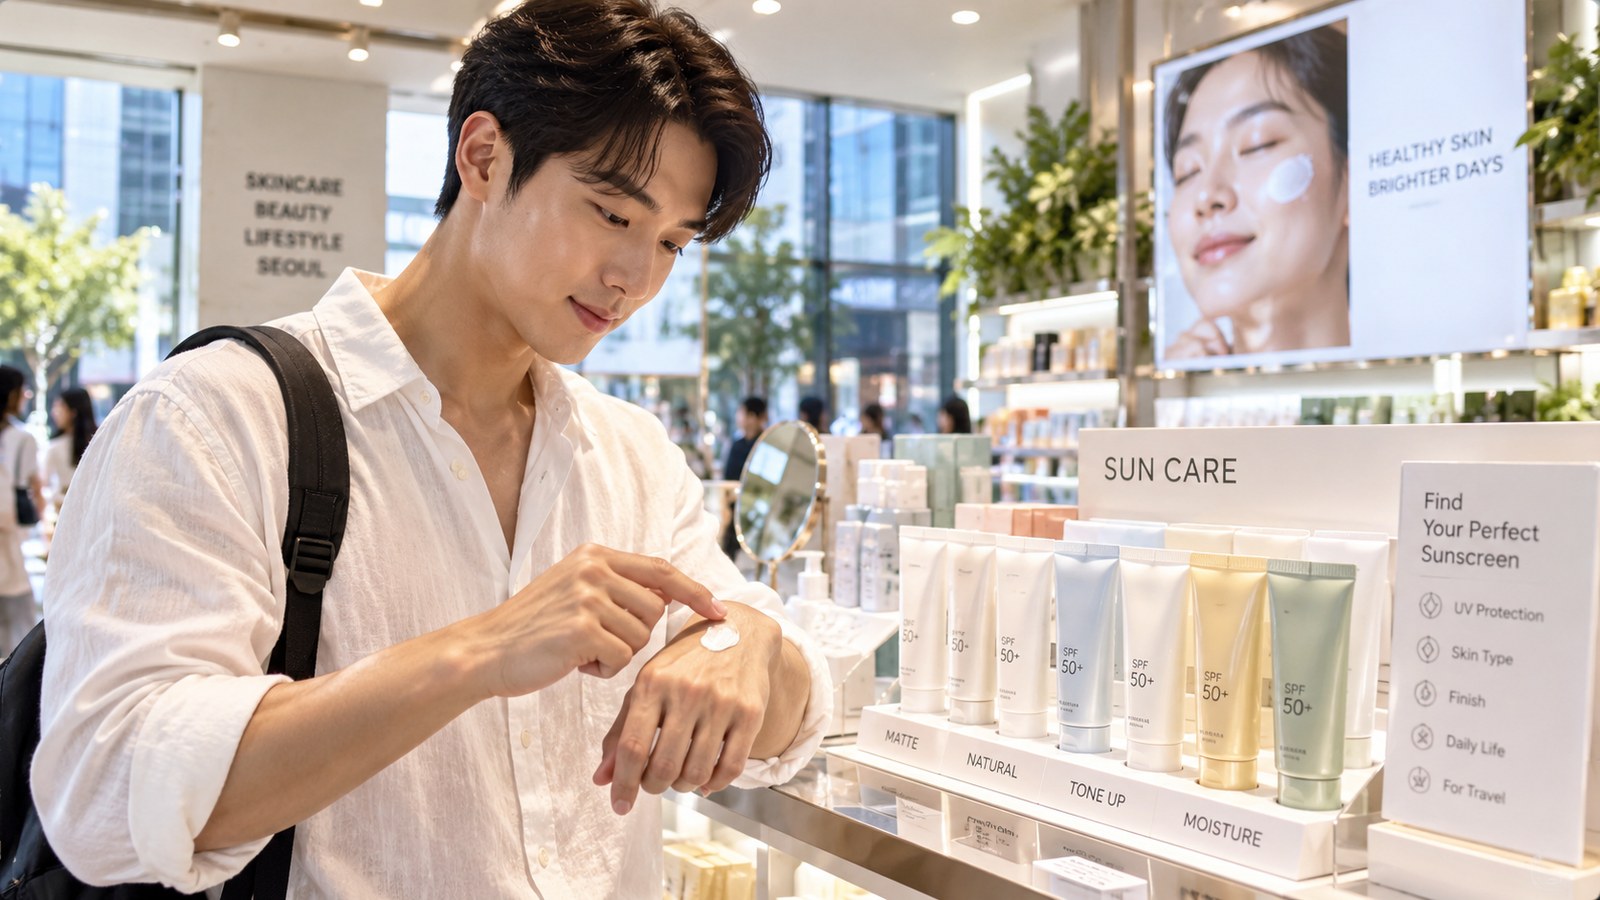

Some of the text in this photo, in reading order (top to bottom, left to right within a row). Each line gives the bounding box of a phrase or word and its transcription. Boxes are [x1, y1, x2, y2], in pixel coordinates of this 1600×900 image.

[1368, 127, 1493, 169] HEALTHY SKIN
[245, 172, 344, 197] SKINCARE
[1368, 155, 1504, 197] BRIGHTER DAYS
[254, 201, 333, 222] BEAUTY
[244, 229, 343, 252] LIFESTYLE
[257, 256, 326, 279] SEOUL
[1104, 456, 1237, 484] SUN CARE
[1424, 492, 1463, 511] Find
[1423, 519, 1540, 542] Your Perfect
[1421, 544, 1520, 569] Sunscreen
[1454, 602, 1544, 622] UV Protection
[1001, 636, 1015, 646] SPF
[1000, 648, 1020, 663] 50+
[1063, 647, 1079, 658] SPF
[1451, 645, 1514, 667] Skin Type
[1061, 659, 1084, 675] 50+
[1132, 659, 1149, 670] SPF
[1130, 672, 1154, 688] 50+
[1204, 671, 1222, 682] SPF
[1202, 684, 1229, 701] 50+
[1284, 683, 1306, 695] SPF
[1449, 690, 1486, 708] Finish
[1283, 697, 1312, 716] 50+
[885, 730, 919, 750] MATTE
[1446, 734, 1506, 758] Daily Life
[966, 752, 1017, 779] NATURAL
[1070, 780, 1126, 808] TONE UP
[1443, 779, 1506, 804] For Travel
[1183, 812, 1263, 848] MOISTURE
